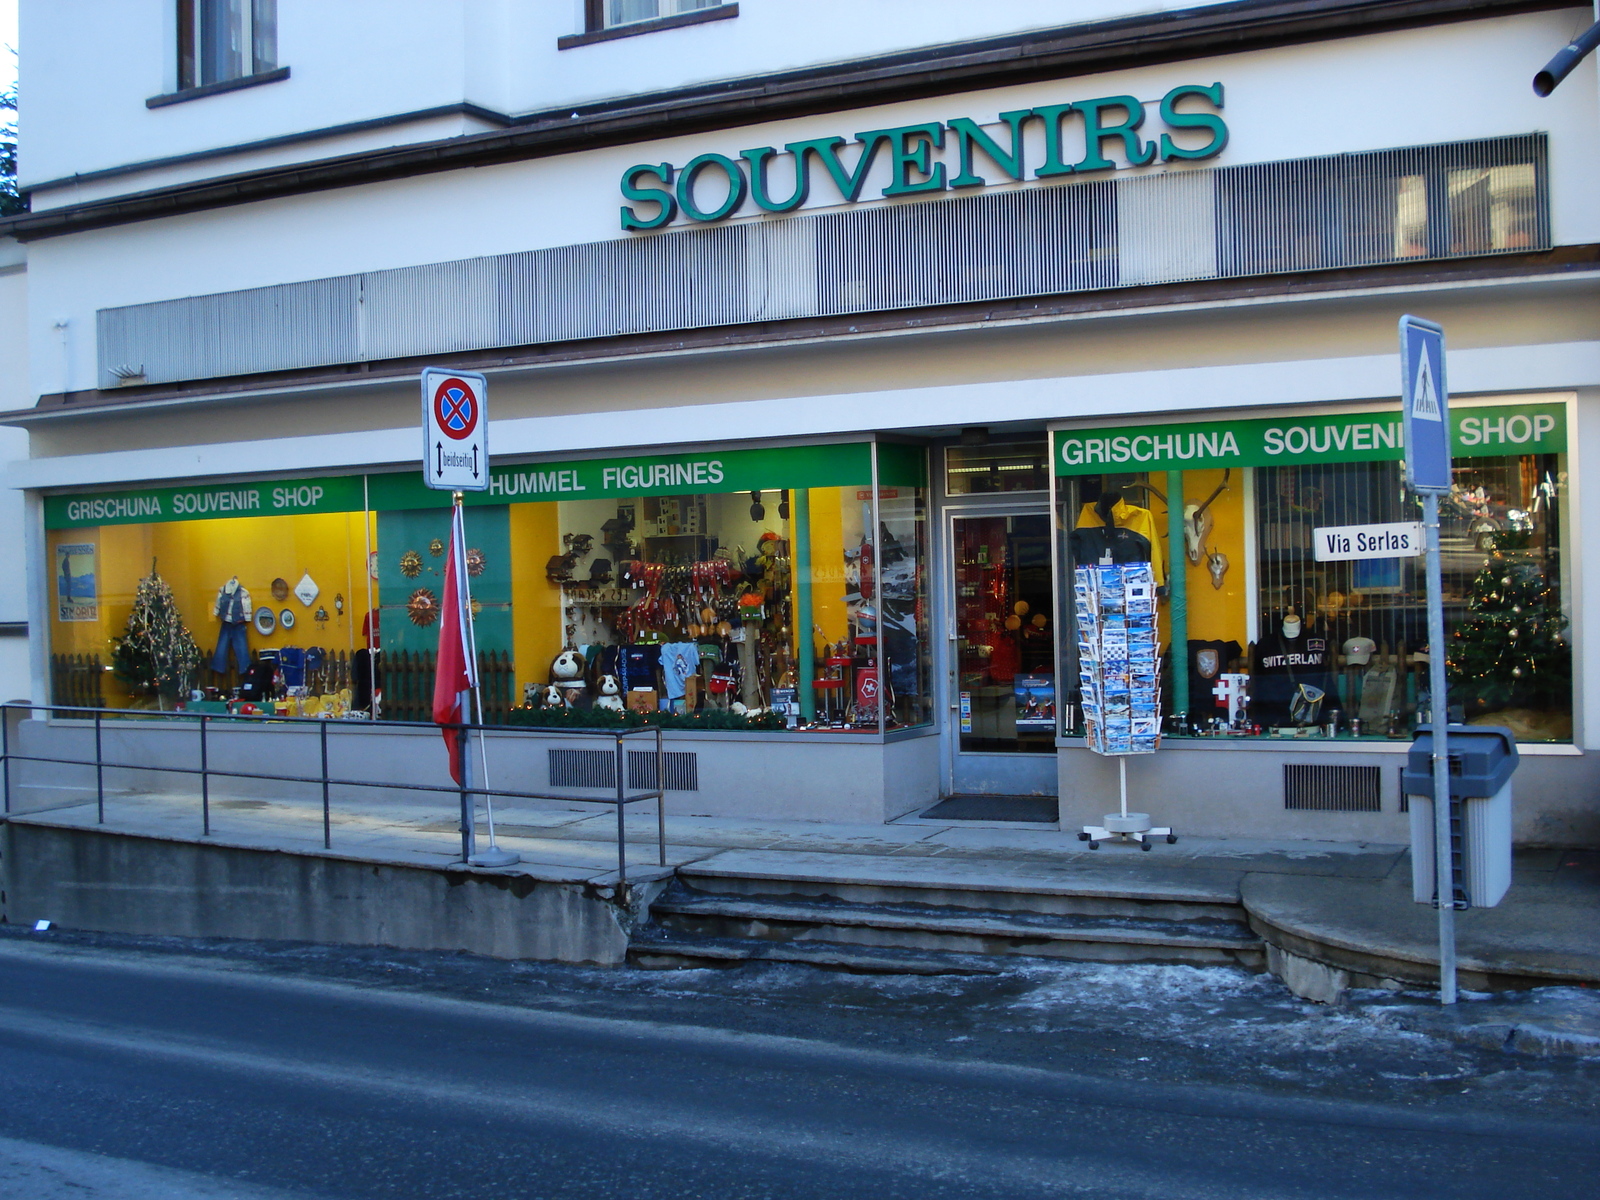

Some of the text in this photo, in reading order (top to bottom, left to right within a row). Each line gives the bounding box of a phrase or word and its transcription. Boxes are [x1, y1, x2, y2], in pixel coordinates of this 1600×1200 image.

[620, 82, 1230, 232] SOUVENIRS
[1061, 415, 1555, 465] GRISCHUNA SOUVENI SHOP
[442, 451, 473, 471] beidseitig
[489, 460, 724, 496] HUMMEL FIGURINES
[67, 486, 324, 521] GRISCHUNA SOUVENIR SHOP
[1326, 531, 1409, 554] Via Serlas
[1262, 653, 1323, 669] SWITZERLAN
